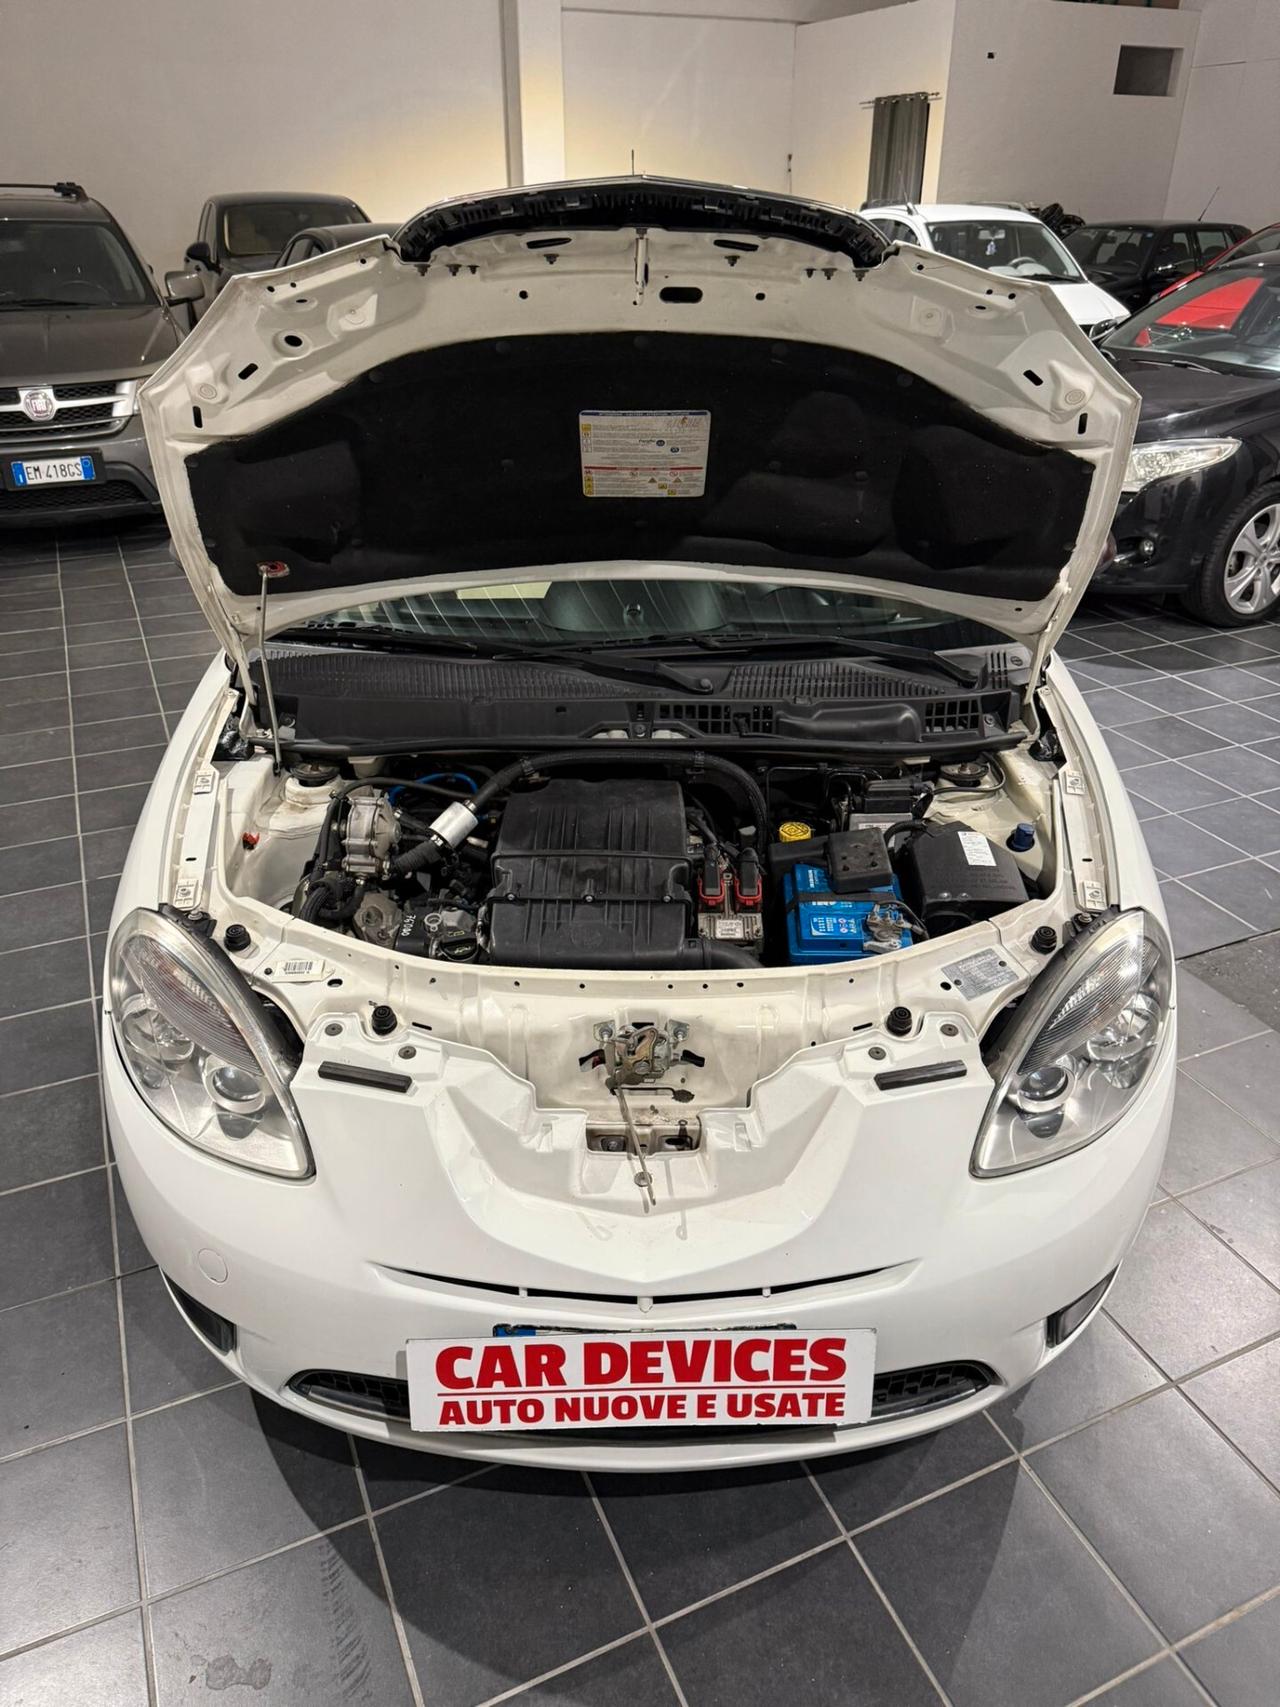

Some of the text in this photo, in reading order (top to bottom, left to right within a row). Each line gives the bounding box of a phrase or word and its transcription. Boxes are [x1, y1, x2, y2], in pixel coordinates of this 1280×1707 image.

[26, 465, 42, 481] EM
[435, 1337, 847, 1390] CAR DEVICES
[439, 1392, 845, 1425] AUTO NUOVE E USATE
